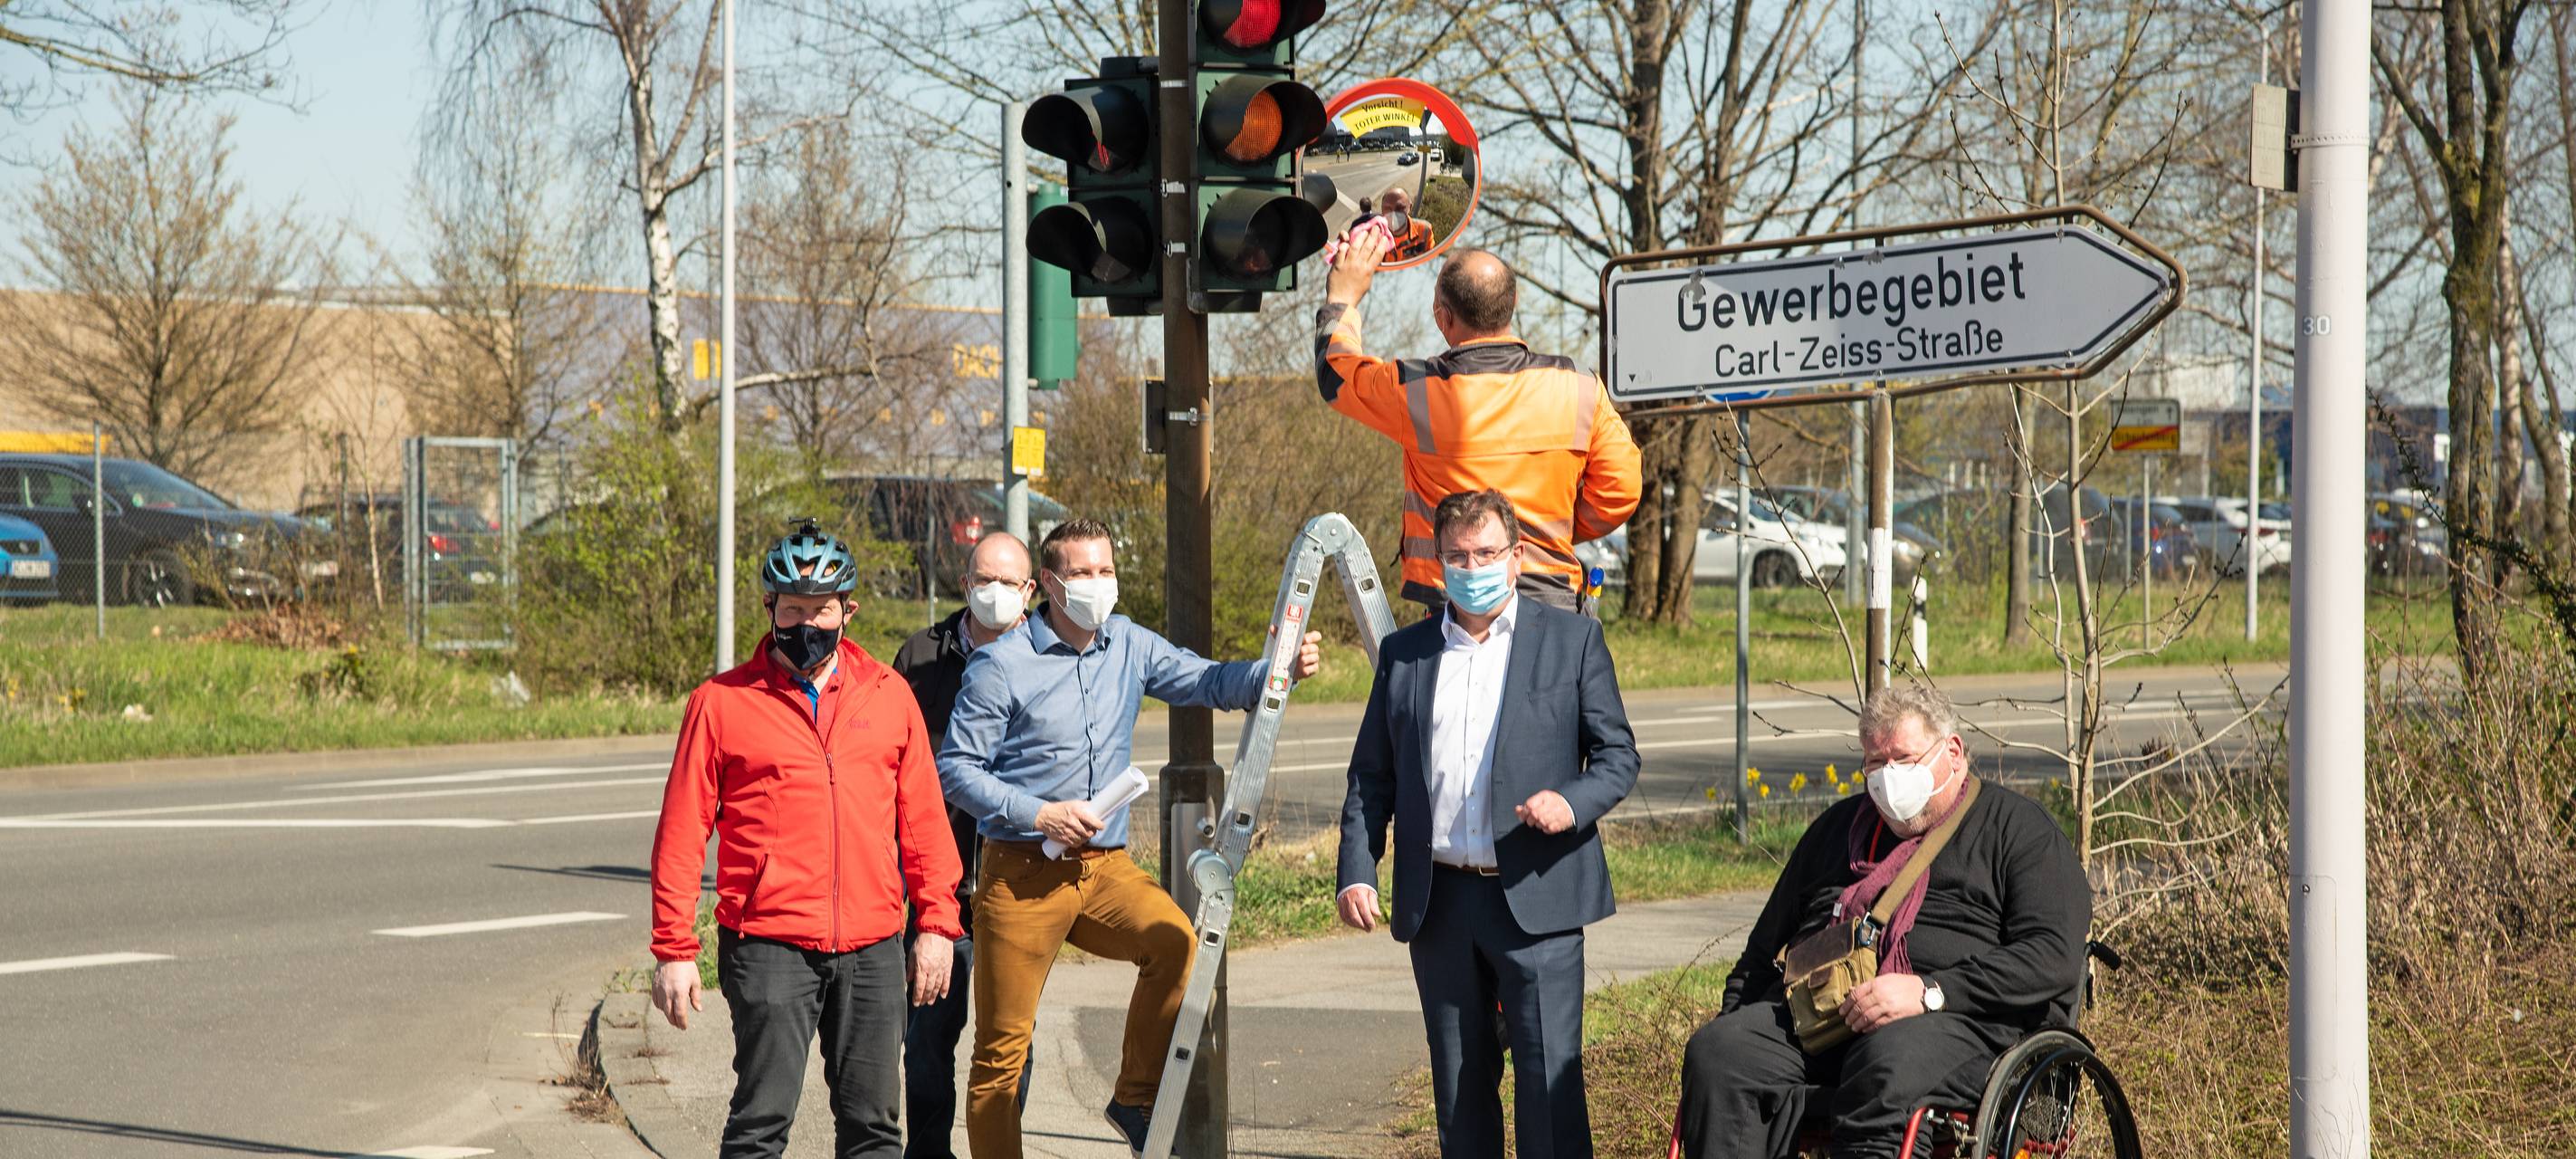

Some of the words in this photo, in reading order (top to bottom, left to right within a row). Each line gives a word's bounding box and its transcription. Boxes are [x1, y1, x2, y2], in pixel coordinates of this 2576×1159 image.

[1677, 252, 2026, 332] Gewerbegebiet
[1715, 320, 2003, 378] Carl-Zeiss-Straße
[2303, 316, 2331, 335] 30
